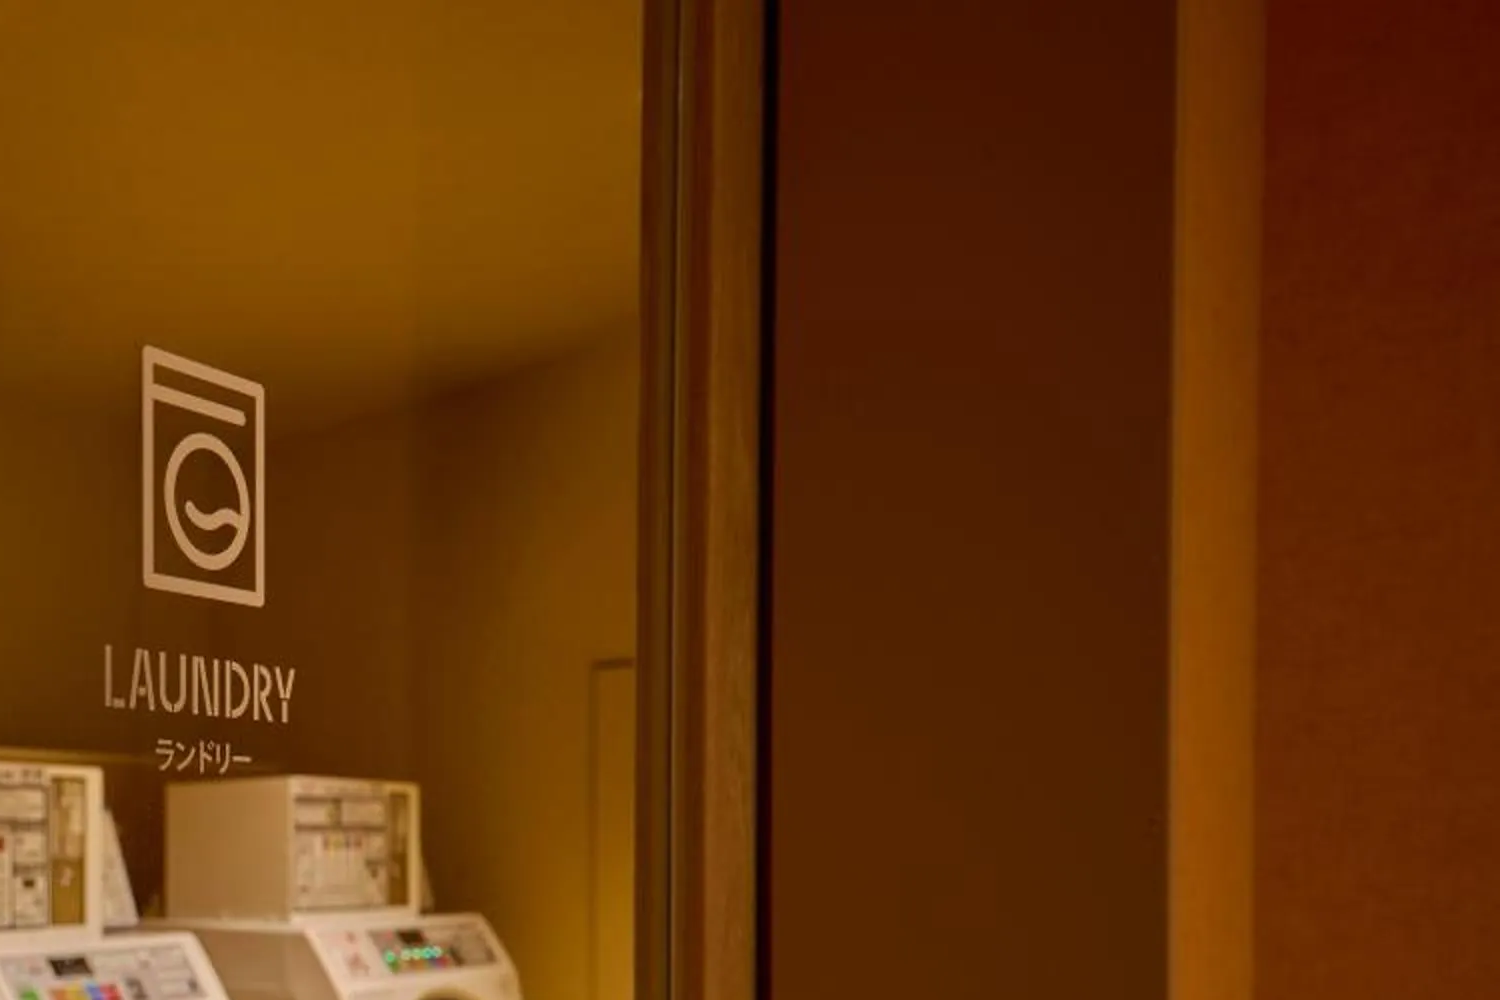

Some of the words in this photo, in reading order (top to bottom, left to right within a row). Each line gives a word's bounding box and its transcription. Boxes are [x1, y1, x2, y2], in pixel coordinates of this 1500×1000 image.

[104, 645, 296, 723] LAUNDRY
[155, 739, 252, 773] ランドリー
